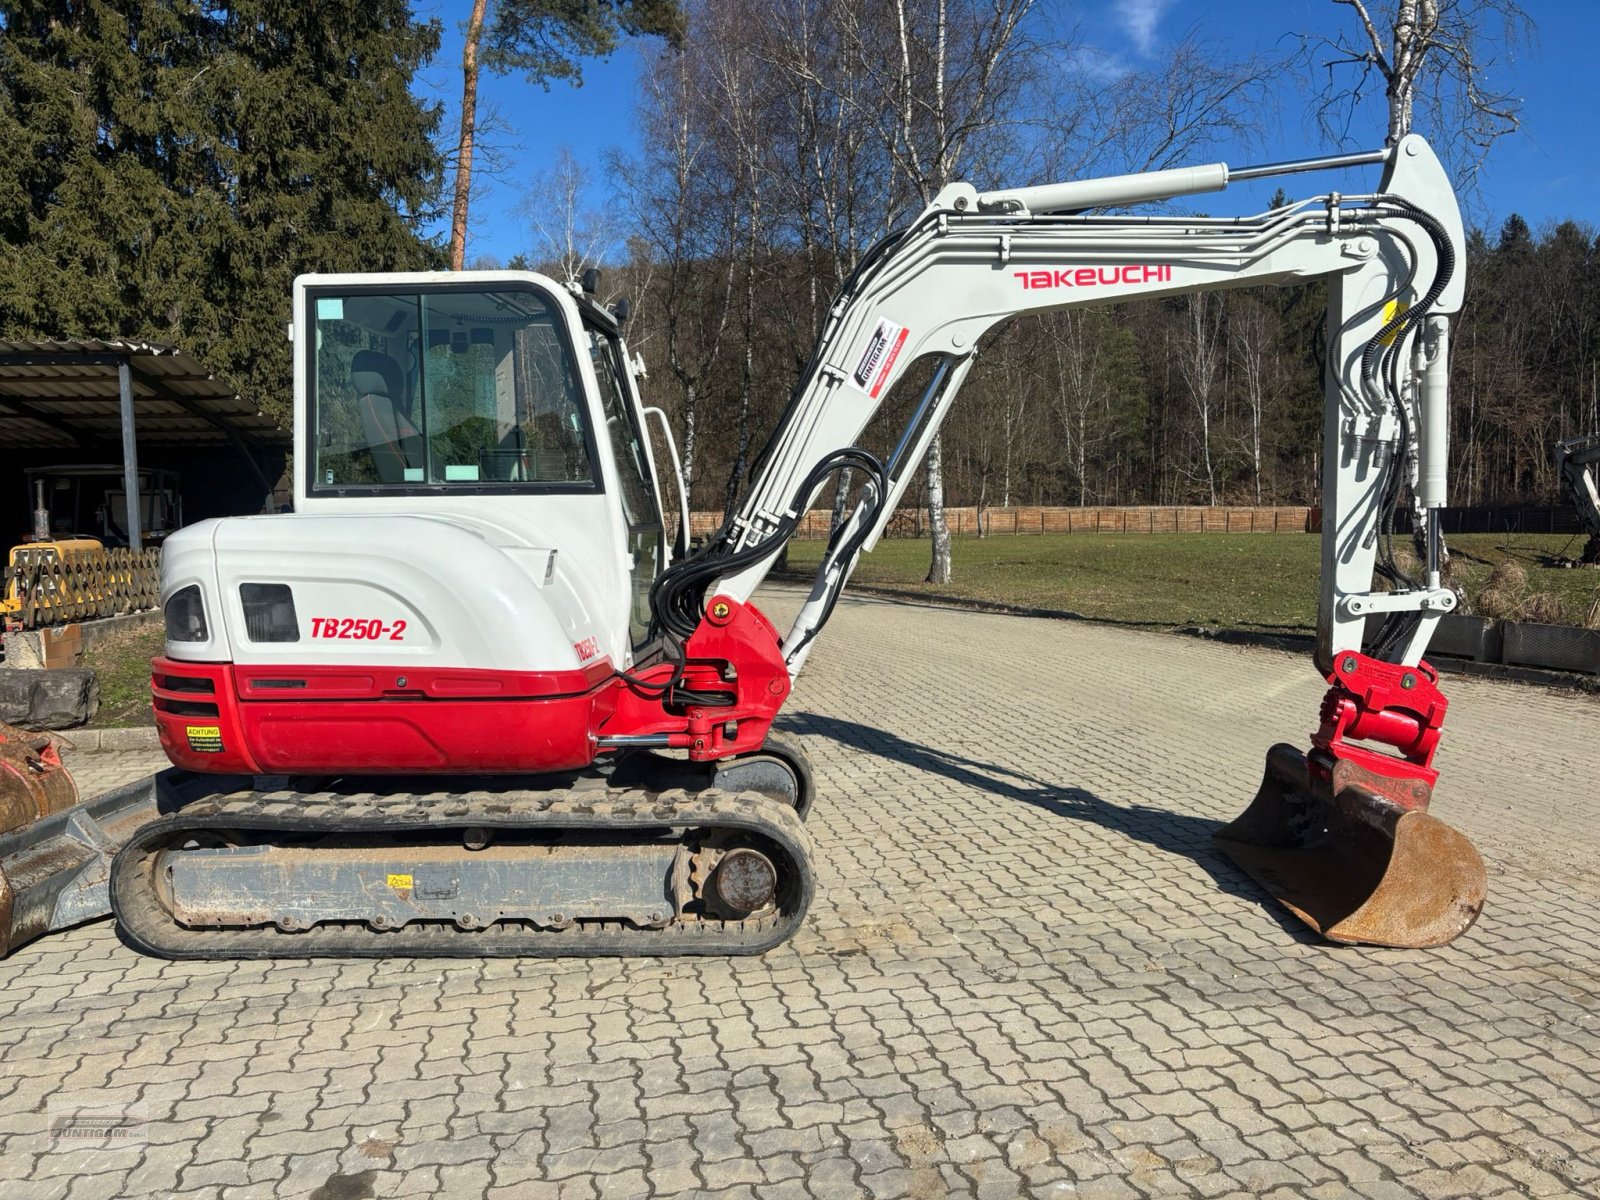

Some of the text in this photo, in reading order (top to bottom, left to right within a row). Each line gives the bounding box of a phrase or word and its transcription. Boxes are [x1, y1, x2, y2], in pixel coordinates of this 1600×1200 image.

[1014, 264, 1171, 289] TAKEUCHI
[311, 618, 407, 640] TB250-2
[188, 728, 219, 736] ACHTUNG
